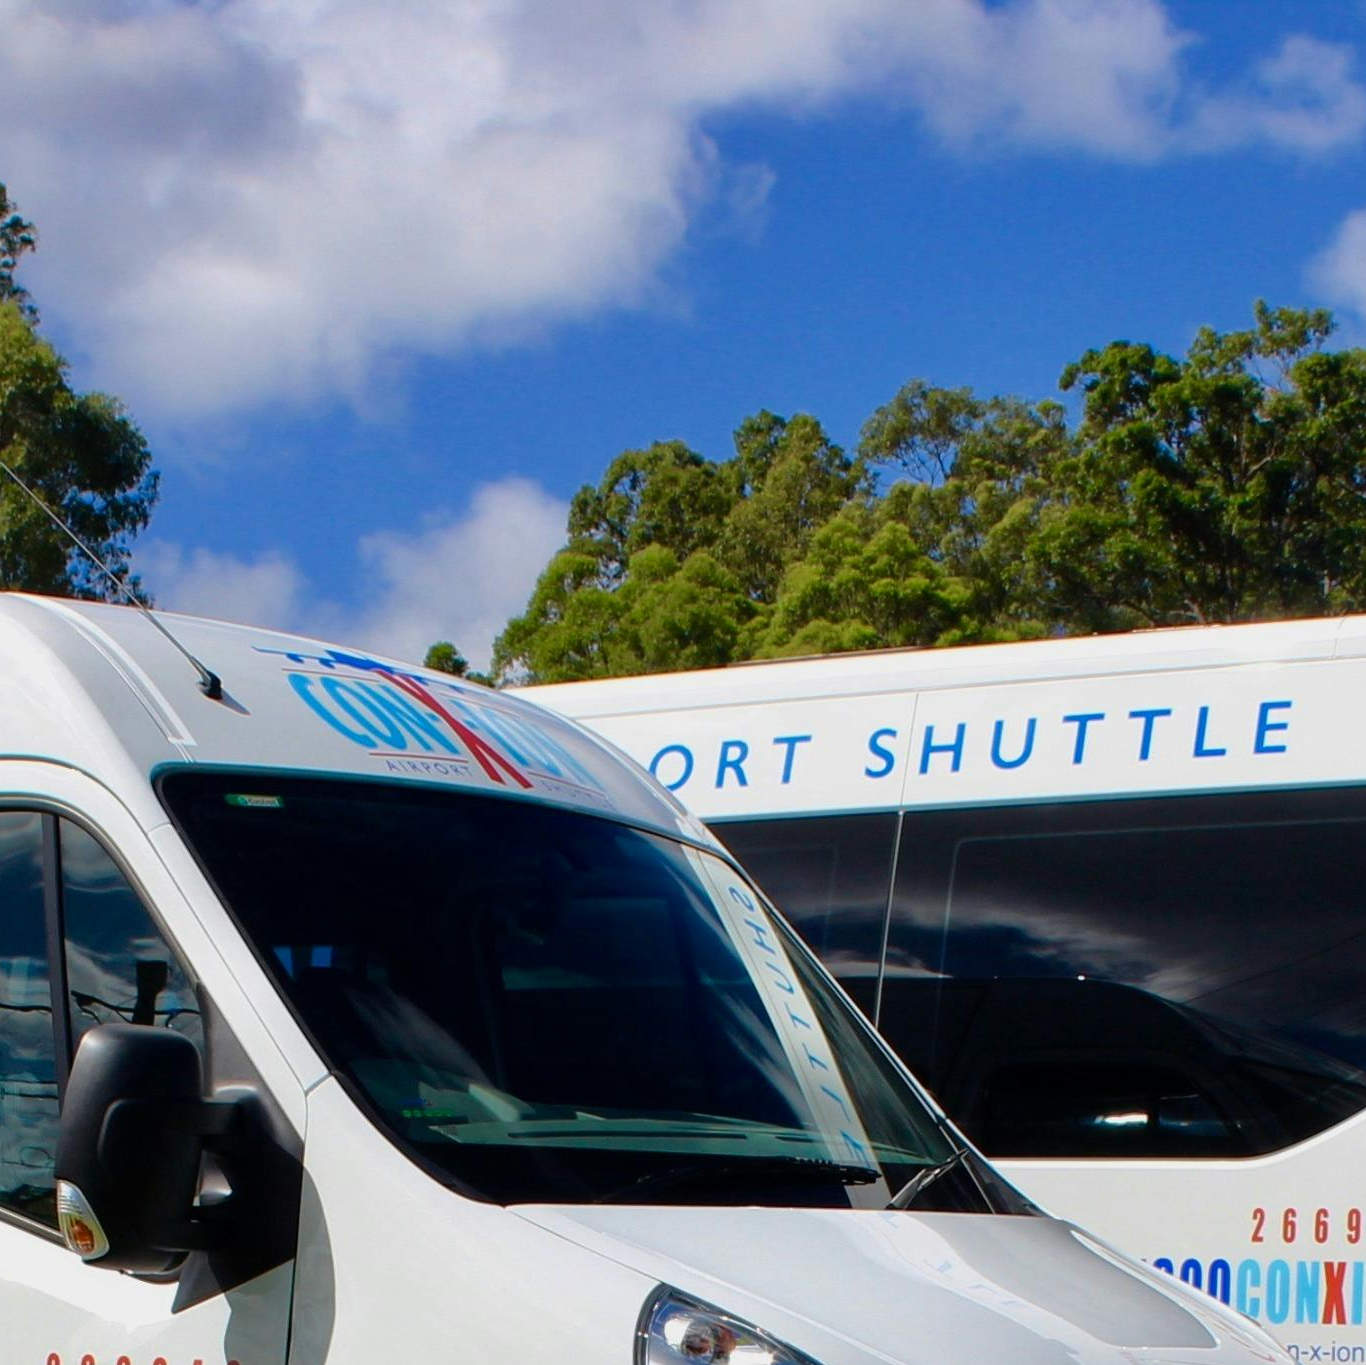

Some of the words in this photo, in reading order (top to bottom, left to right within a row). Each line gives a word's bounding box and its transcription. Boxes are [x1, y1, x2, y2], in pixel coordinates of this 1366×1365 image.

[386, 759, 473, 778] AIRPORT
[649, 735, 812, 790] ORT
[865, 701, 1292, 779] SHUTTLE
